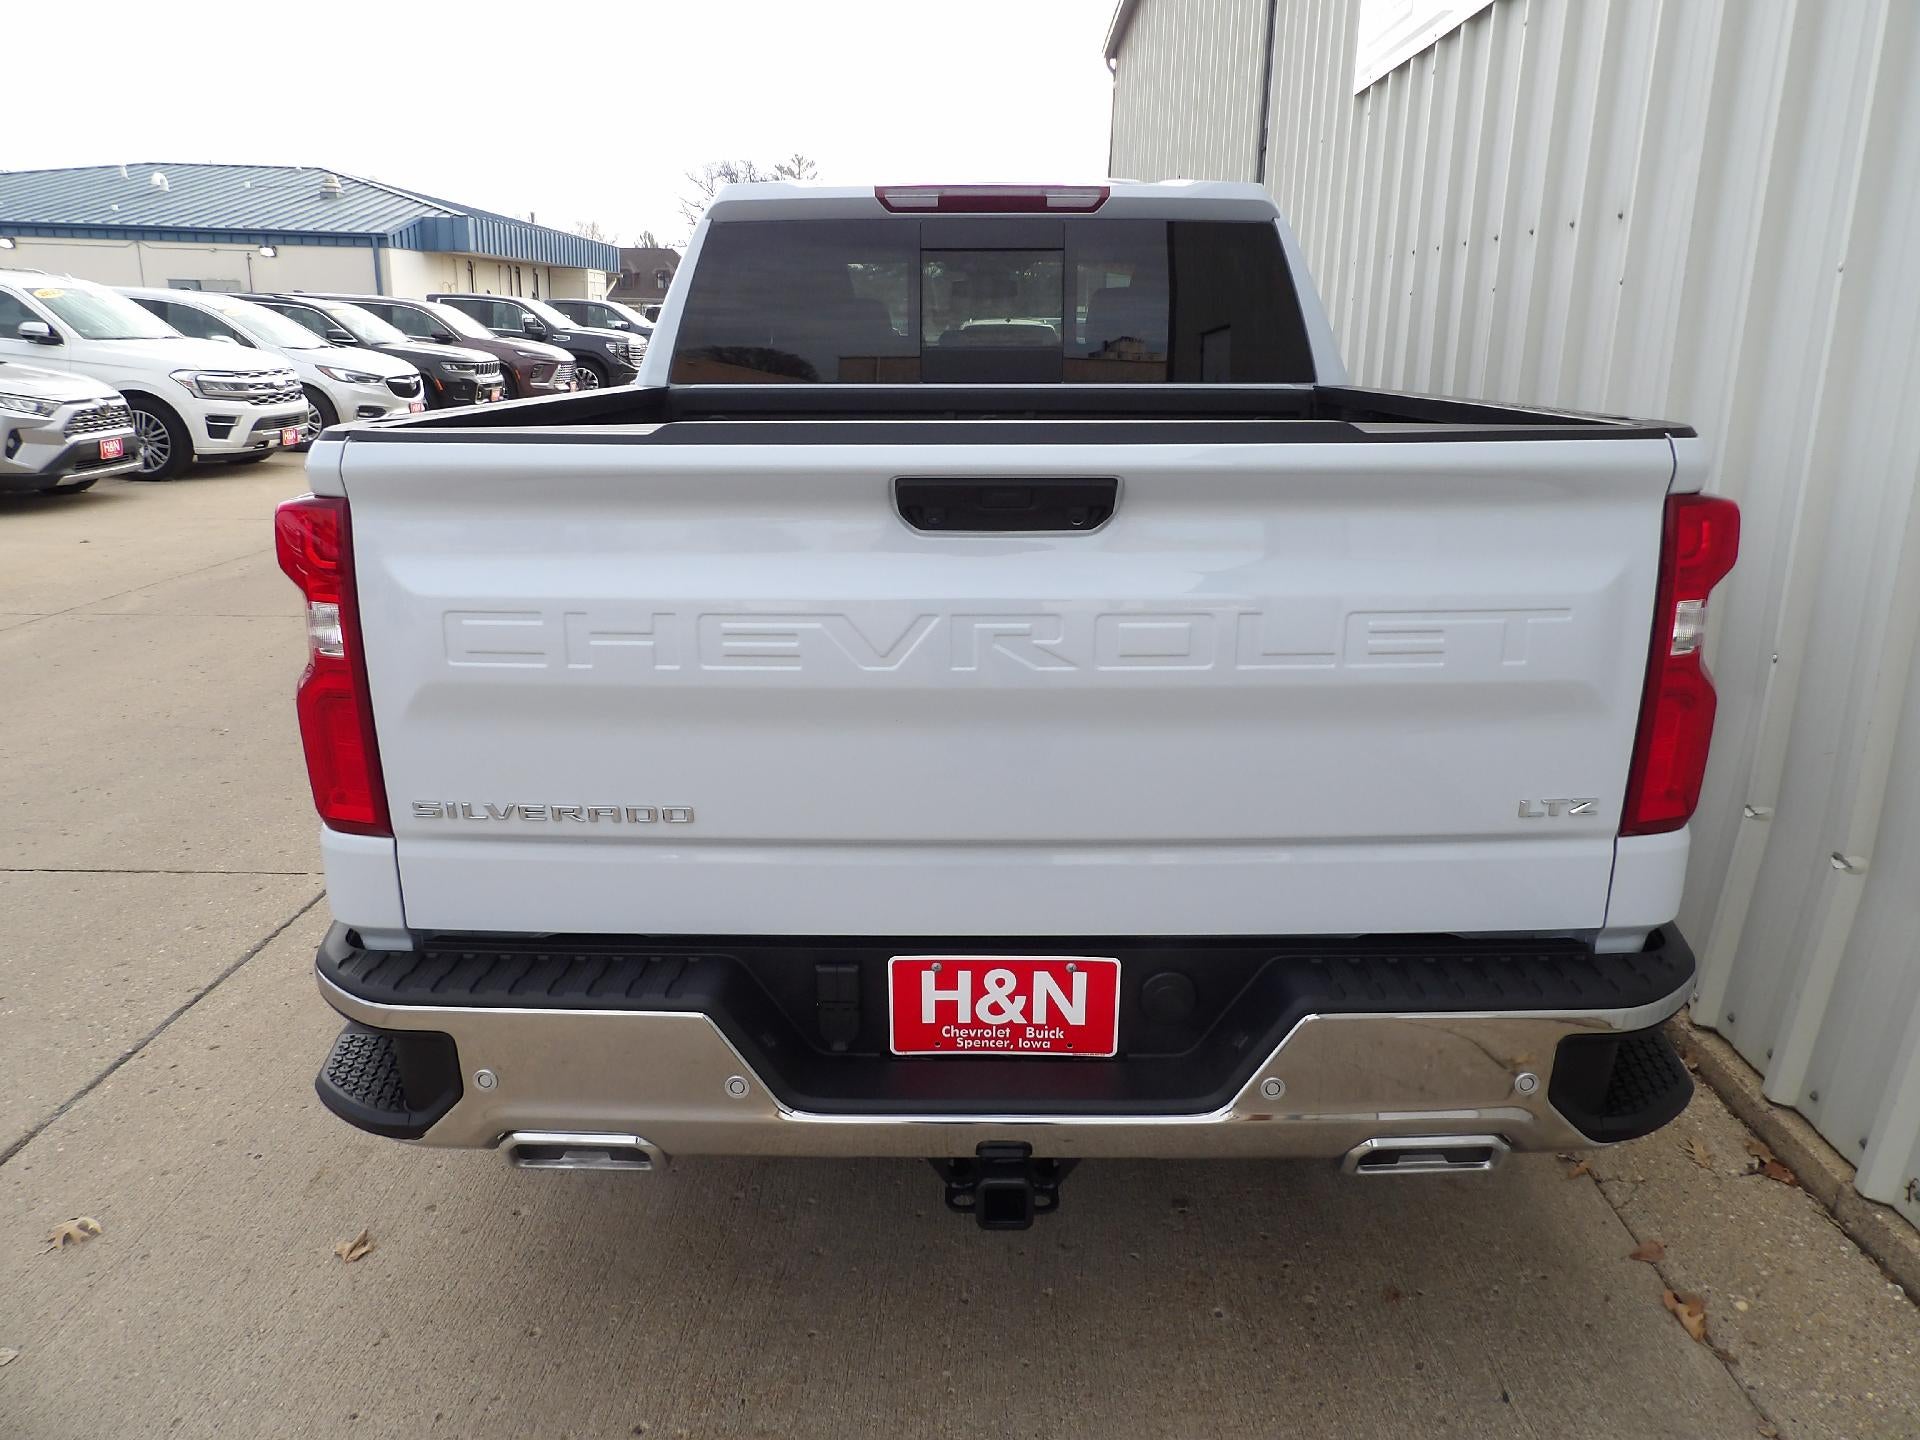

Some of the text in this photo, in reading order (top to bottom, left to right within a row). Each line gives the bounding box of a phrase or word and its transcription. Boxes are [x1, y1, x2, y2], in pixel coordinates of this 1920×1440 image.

[103, 440, 120, 452] H&N
[443, 608, 1574, 672] CHEVROLET
[411, 801, 695, 823] SILVERADO
[1518, 798, 1599, 818] LTZ
[921, 968, 1088, 1026] H&N
[941, 1024, 1064, 1039] Chevrolet Buick
[956, 1037, 1051, 1049] Spencer, Iowa
